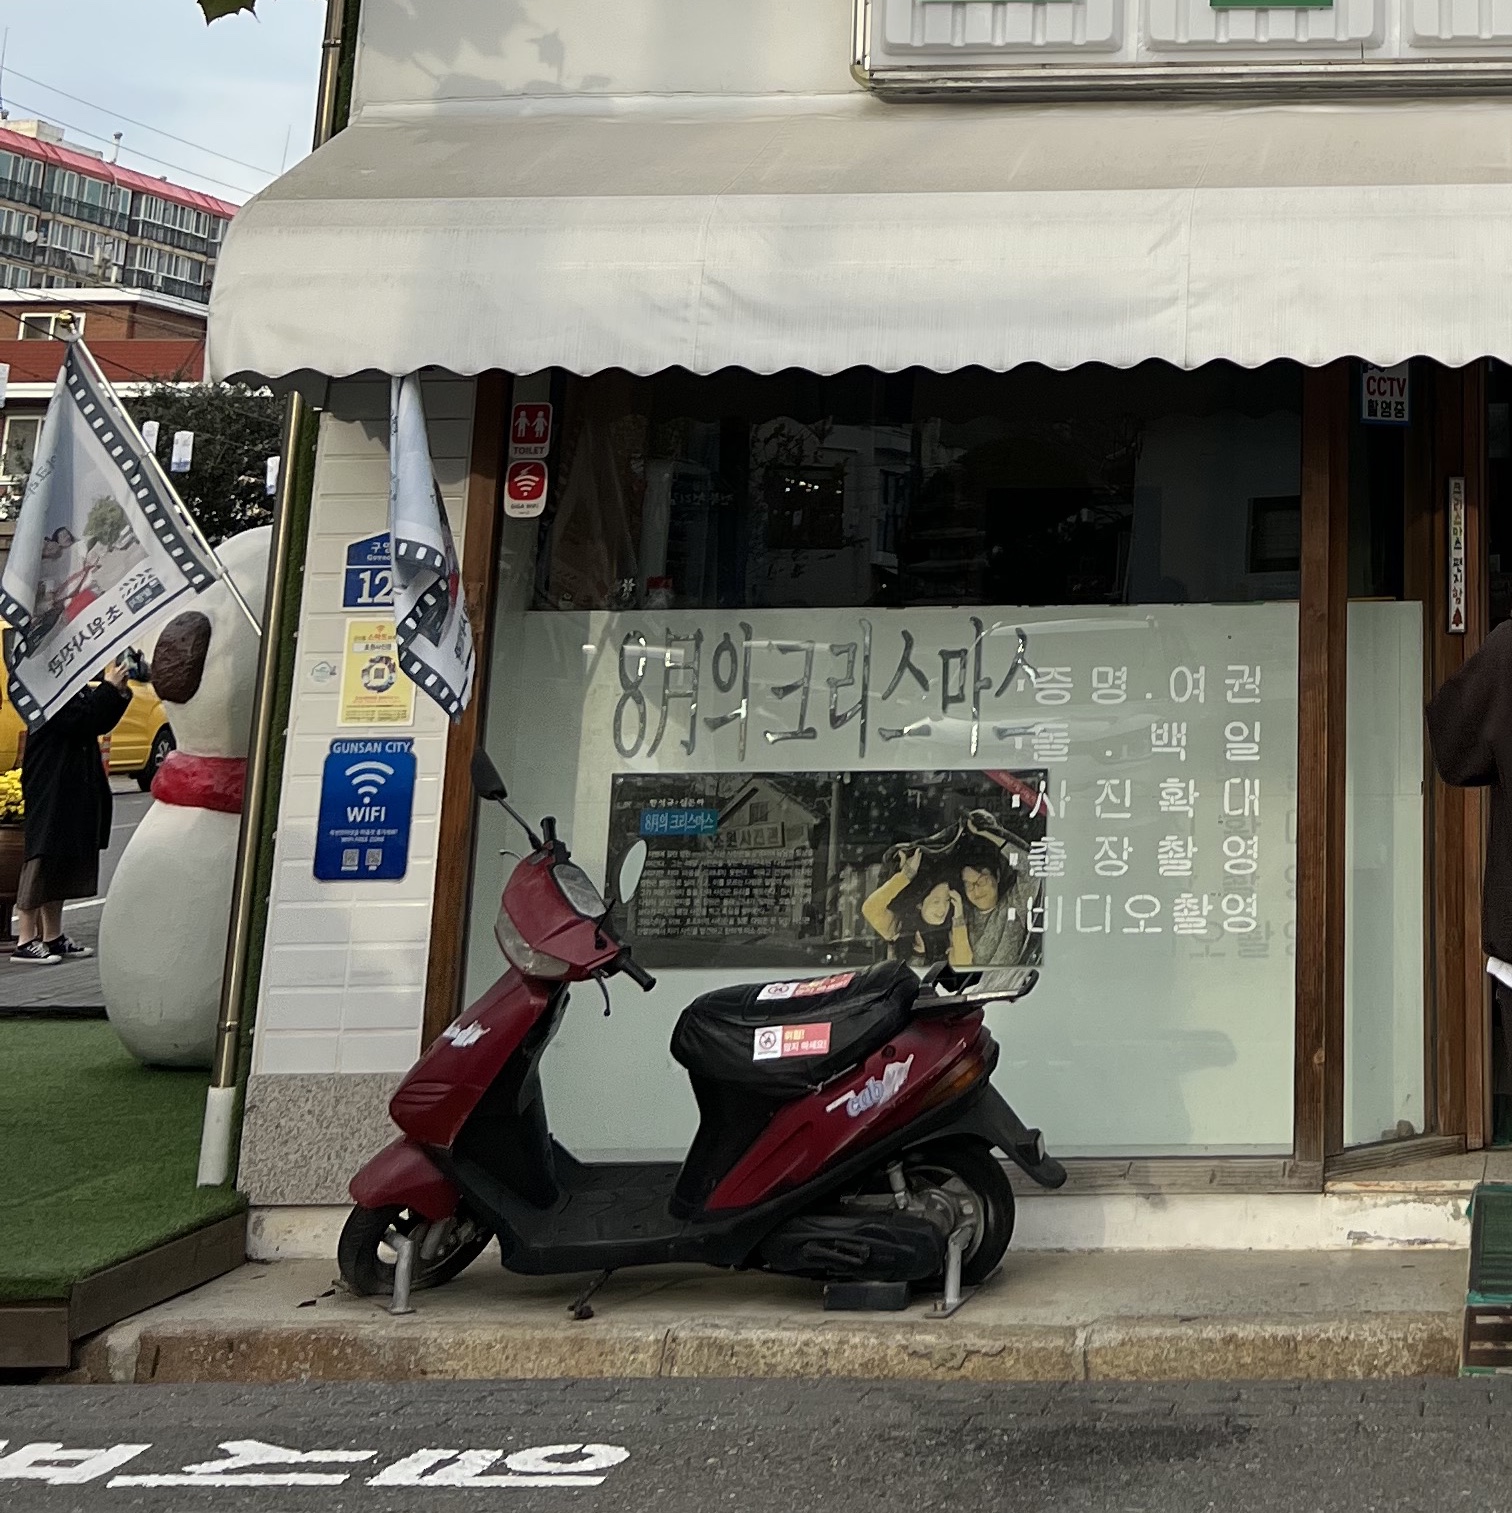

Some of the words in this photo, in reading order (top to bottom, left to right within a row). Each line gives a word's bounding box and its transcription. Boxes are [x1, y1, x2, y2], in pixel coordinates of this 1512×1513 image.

[1366, 375, 1407, 397] CCTV
[514, 446, 545, 455] TOILET
[332, 741, 382, 754] GUNSAN
[385, 741, 411, 754] CITY
[346, 806, 386, 823] WIFI
